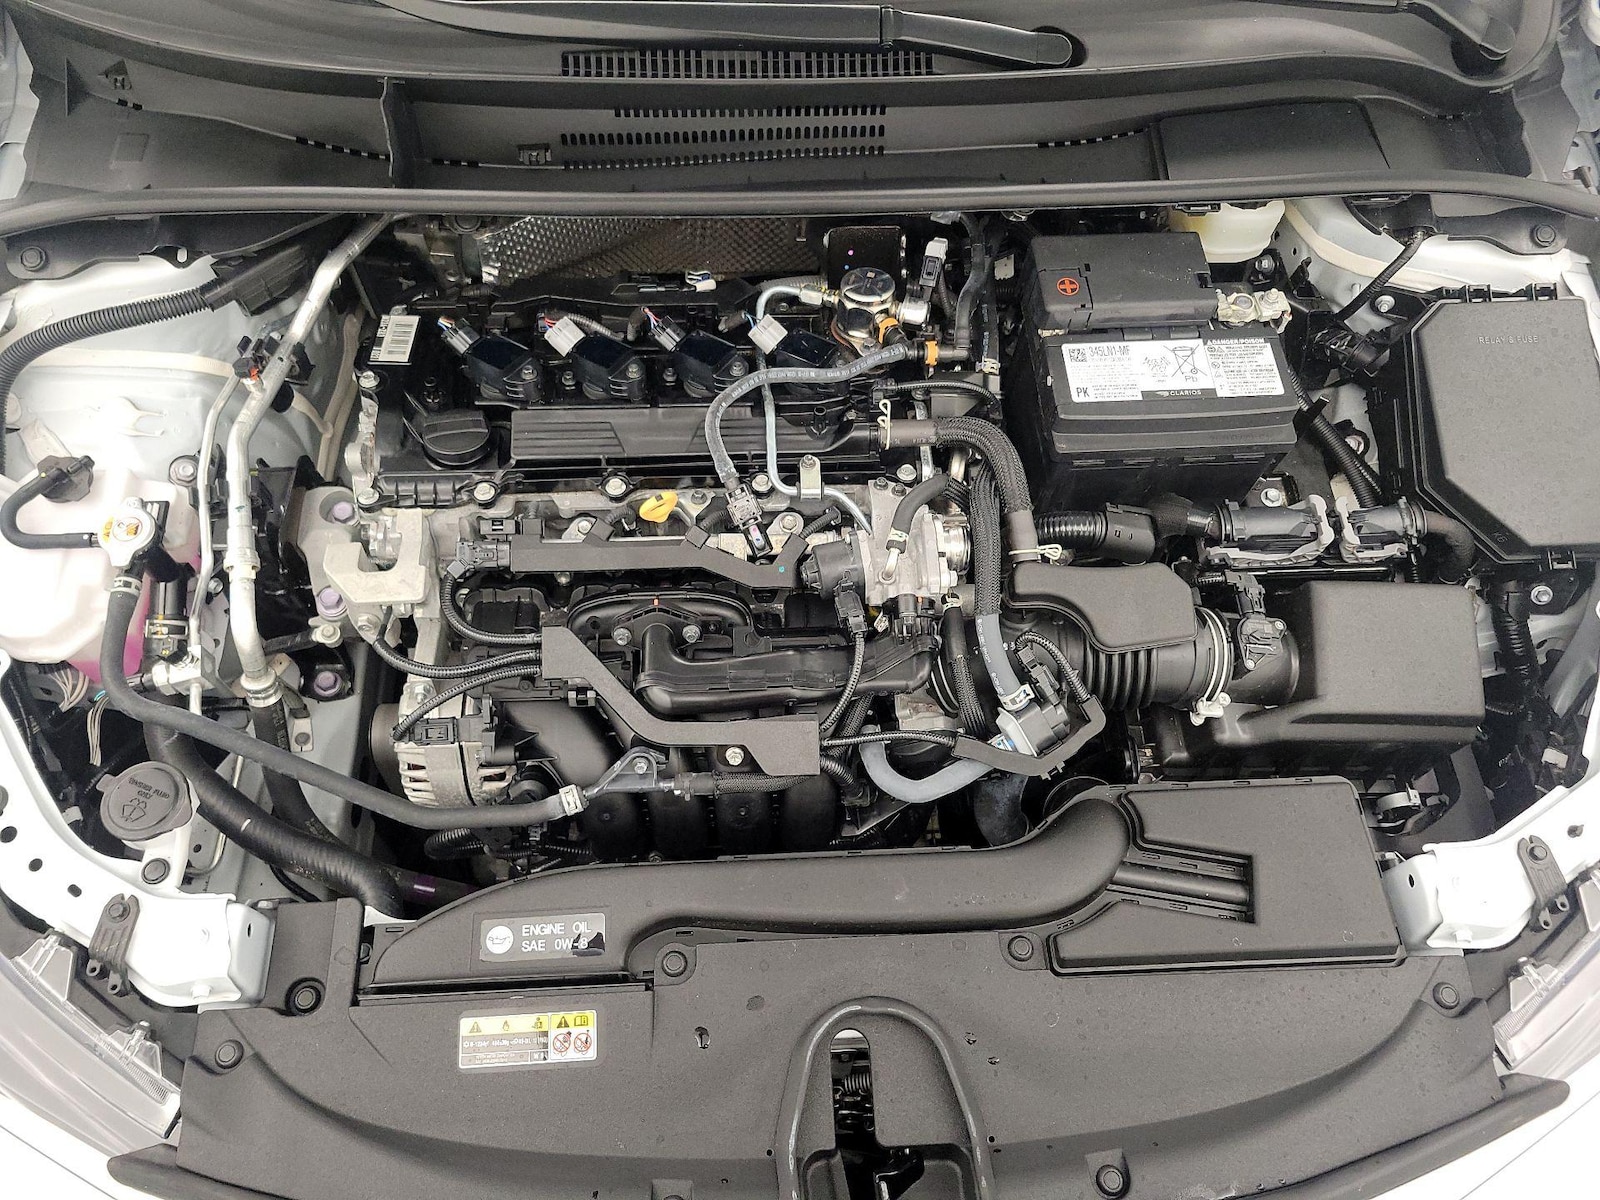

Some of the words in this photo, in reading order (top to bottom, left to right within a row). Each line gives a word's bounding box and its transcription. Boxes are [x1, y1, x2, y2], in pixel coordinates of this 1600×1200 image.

[1478, 336, 1504, 344] RELAY
[1516, 335, 1538, 343] FUSE
[1185, 375, 1198, 383] Pb
[1076, 387, 1090, 398] PK
[521, 922, 565, 937] ENGINE
[572, 921, 592, 933] OIL
[521, 941, 546, 952] SAE
[554, 937, 589, 950] 0W-8
